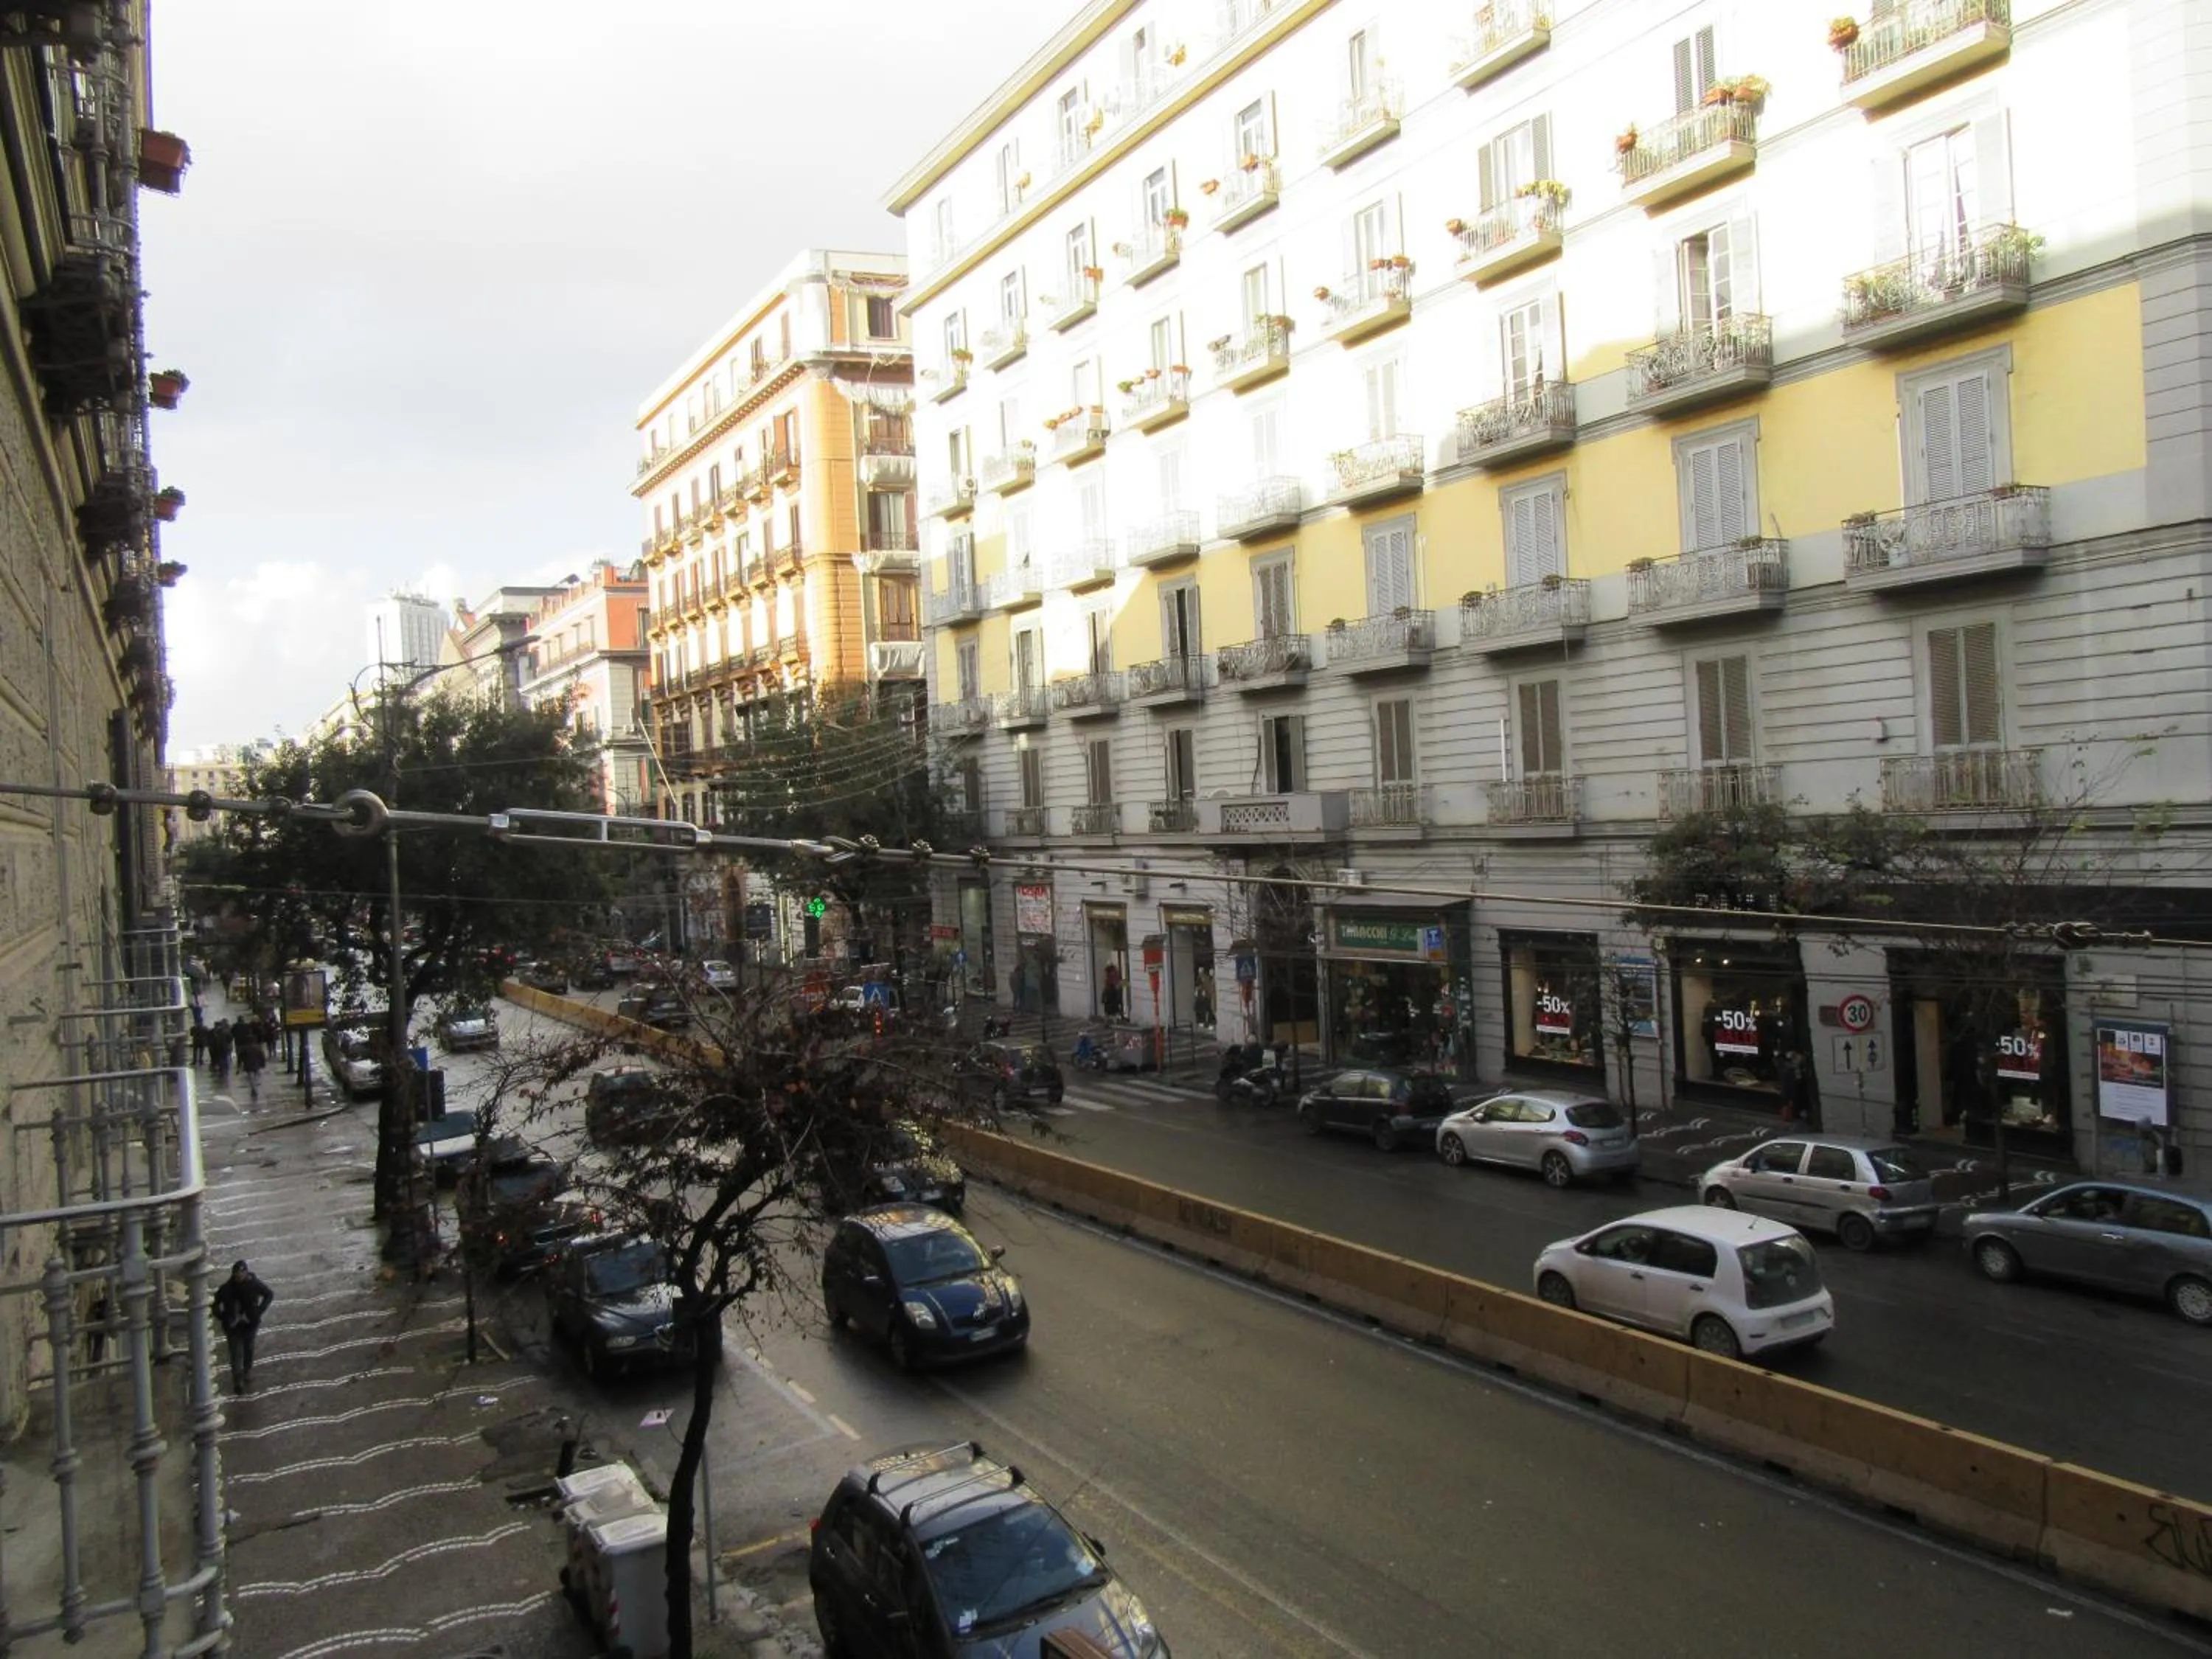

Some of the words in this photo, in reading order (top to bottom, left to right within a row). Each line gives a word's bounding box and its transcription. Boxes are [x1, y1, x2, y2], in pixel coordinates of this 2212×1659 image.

[1537, 995, 1571, 1014] -50%
[1848, 1005, 1867, 1023] 30
[1714, 1010, 1757, 1032] -50%
[1995, 1036, 2040, 1059] -50%
